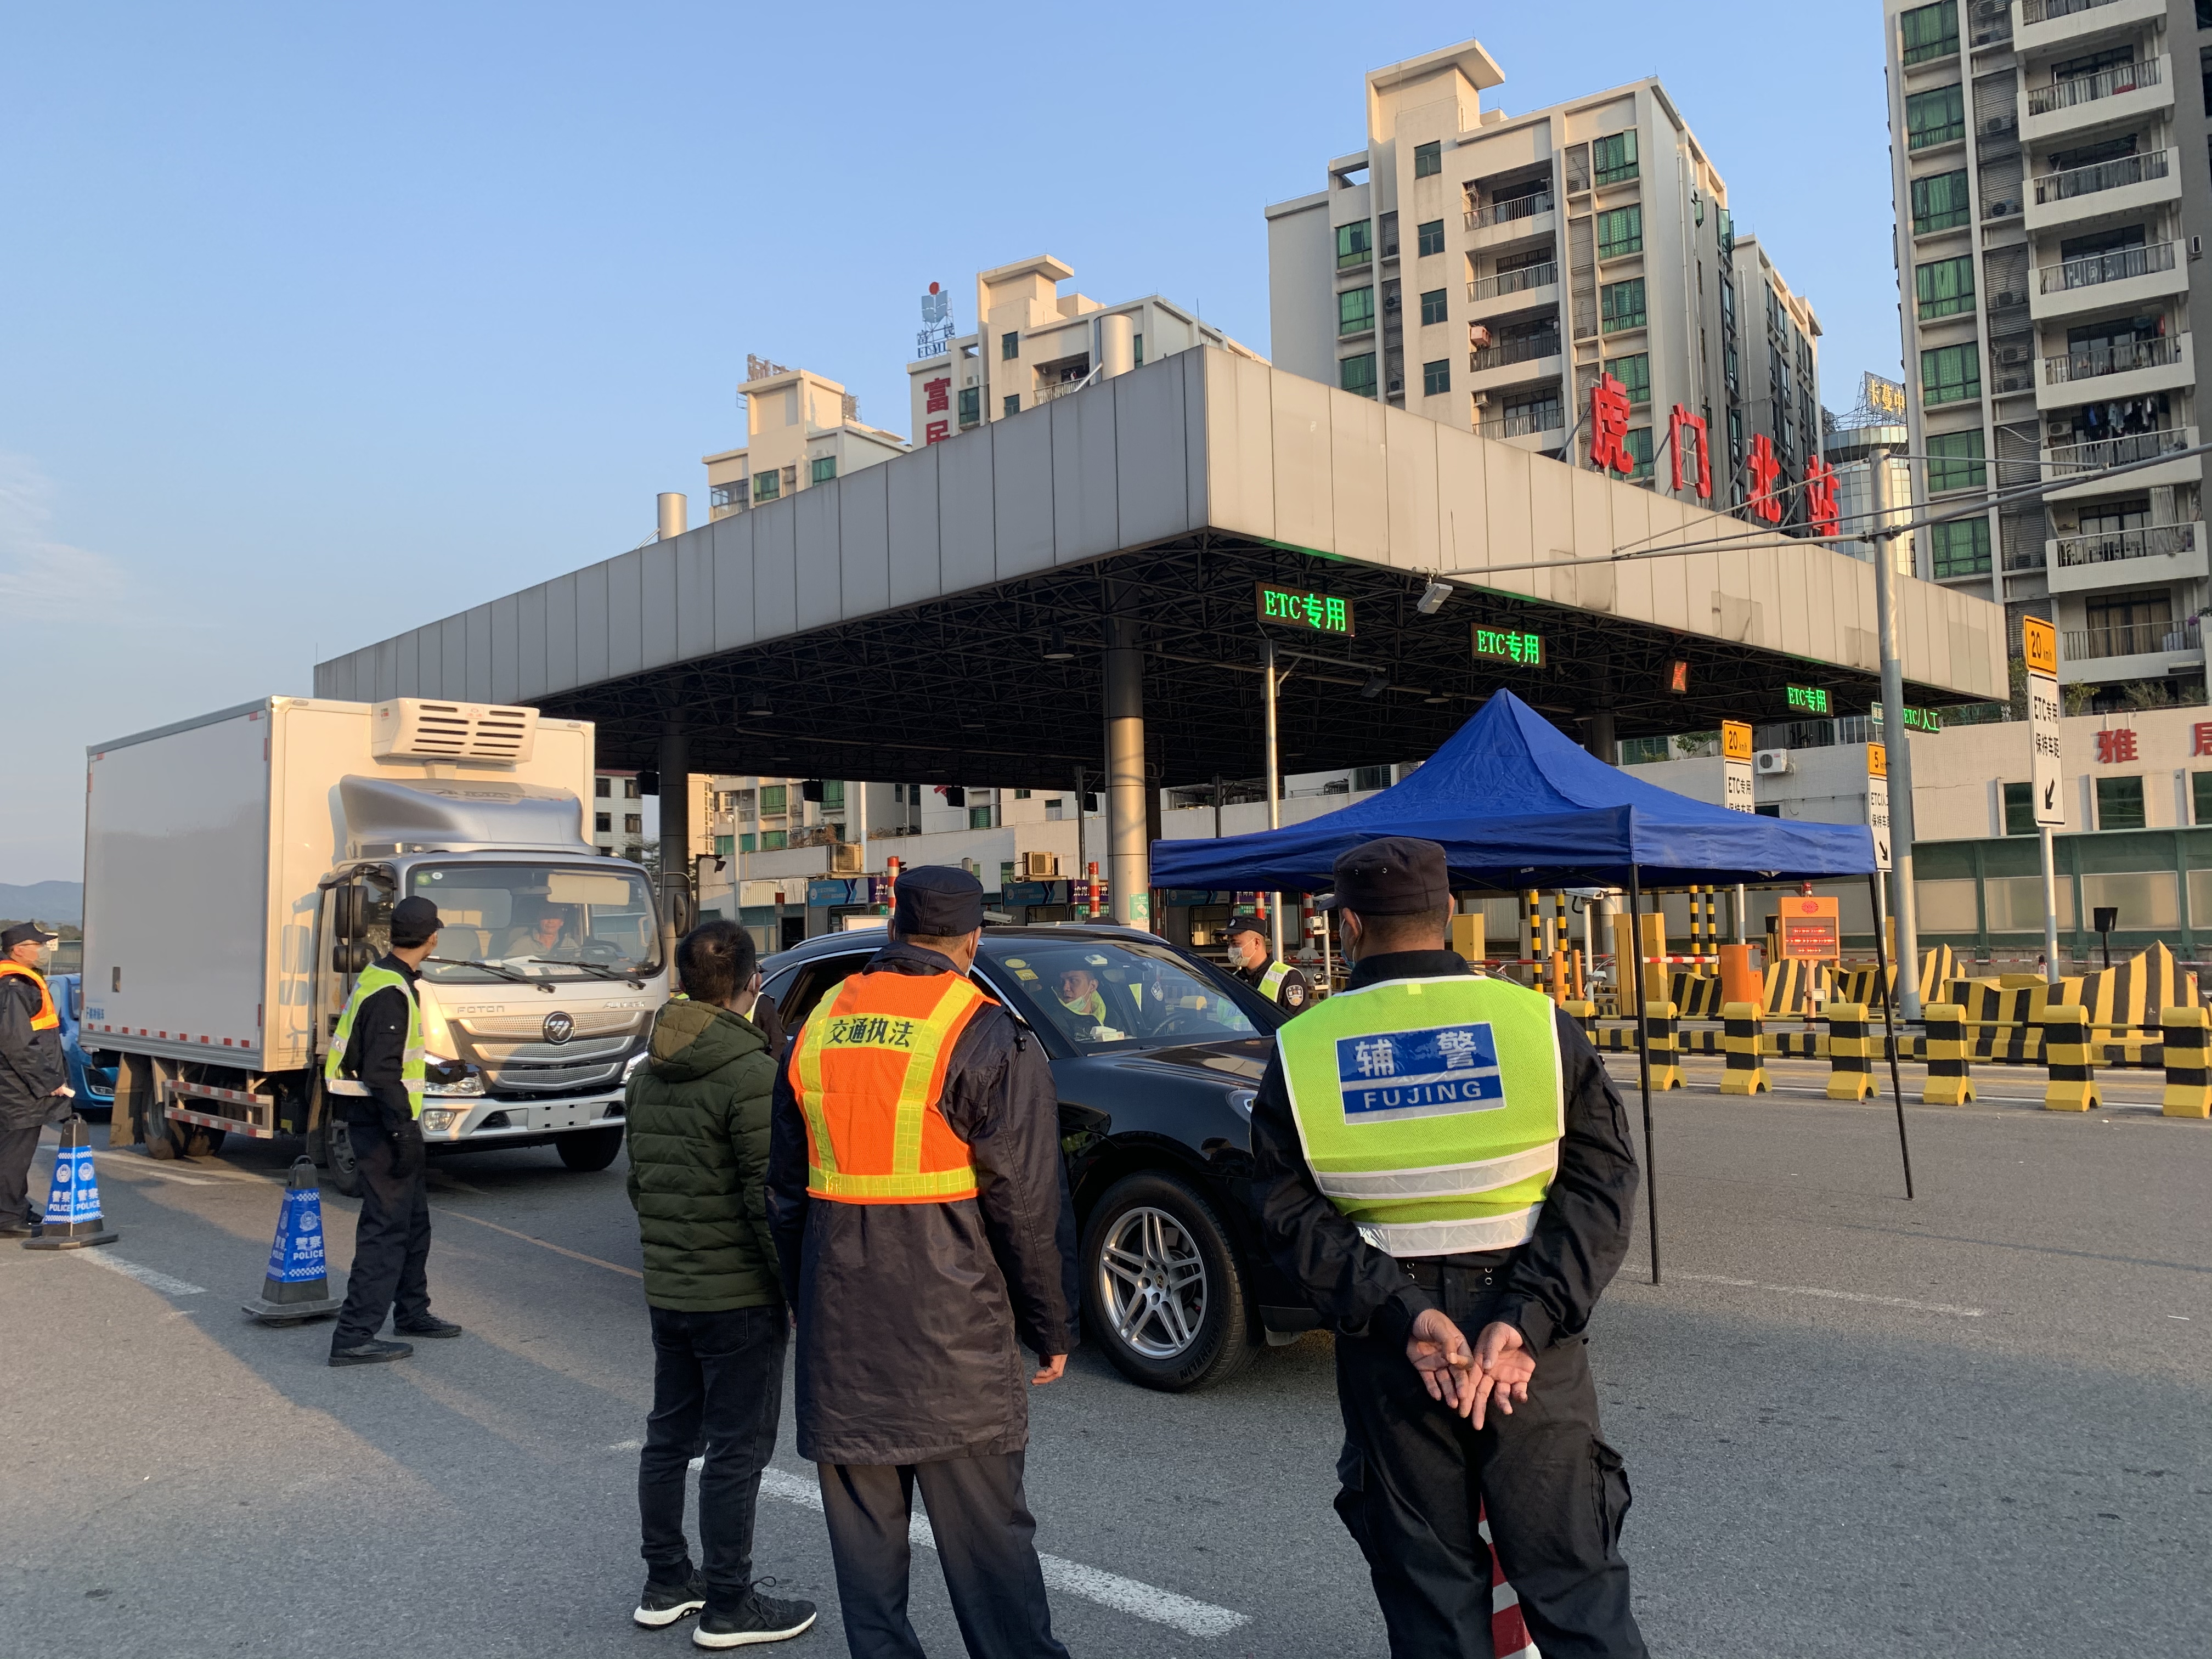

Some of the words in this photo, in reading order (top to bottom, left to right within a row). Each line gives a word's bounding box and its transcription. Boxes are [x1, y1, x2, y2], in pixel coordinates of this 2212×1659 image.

[1590, 371, 1840, 537] 虎门北站
[1264, 590, 1346, 631] ETC专用
[1477, 630, 1539, 664] ETC专用
[2031, 630, 2041, 659] 20
[2044, 647, 2052, 662] km/h
[1787, 687, 1826, 713] ETC专用
[2034, 696, 2057, 724] ETC专用
[1903, 708, 1940, 731] ETC/人工
[1729, 730, 1737, 750] 20
[2036, 732, 2059, 758] 保持车距
[1875, 751, 1878, 768] 5
[1728, 777, 1751, 795] ETC专用
[825, 1018, 914, 1047] 交通执法
[1355, 1030, 1477, 1077] 辅警
[1363, 1081, 1482, 1109] FUJING
[52, 1190, 71, 1202] 警察
[76, 1200, 100, 1211] POLICE
[77, 1188, 99, 1201] 警察
[49, 1204, 71, 1212] POLICE
[295, 1235, 322, 1250] 警察
[293, 1249, 324, 1261] POLICE
